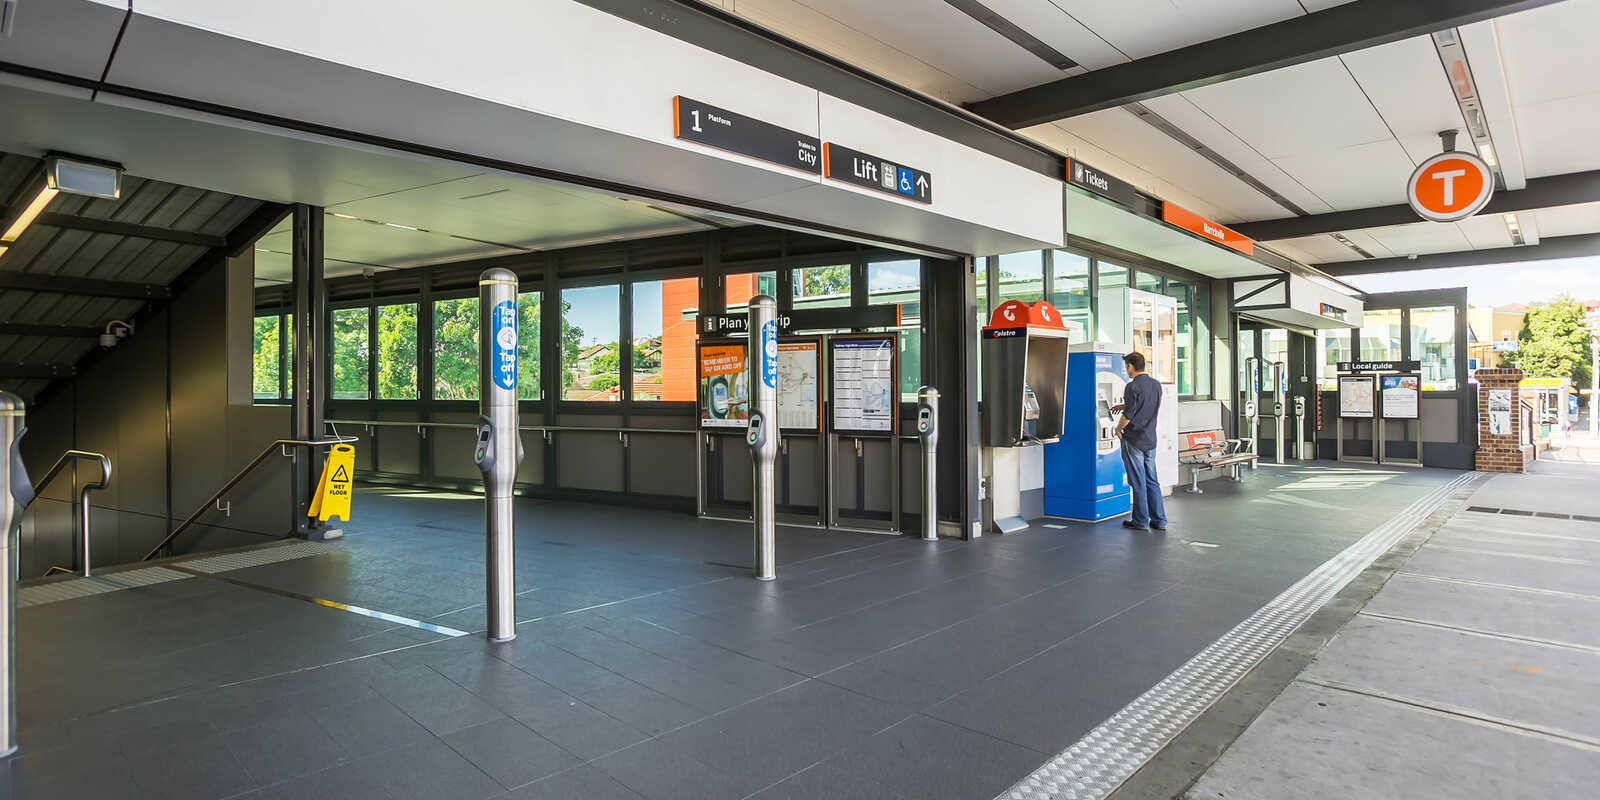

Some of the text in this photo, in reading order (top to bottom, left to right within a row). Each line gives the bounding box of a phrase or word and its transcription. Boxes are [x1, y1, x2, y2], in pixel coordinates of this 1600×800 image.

[691, 110, 703, 133] 1
[708, 114, 732, 126] Platform
[798, 149, 817, 167] City
[853, 157, 878, 182] Lift
[1085, 169, 1108, 191] Tickets
[1432, 168, 1466, 206] T
[499, 305, 515, 317] Tap
[502, 316, 514, 325] on
[720, 317, 742, 329] Plan
[993, 330, 1016, 338] Telstra
[499, 351, 516, 364] Tap
[500, 363, 515, 373] off
